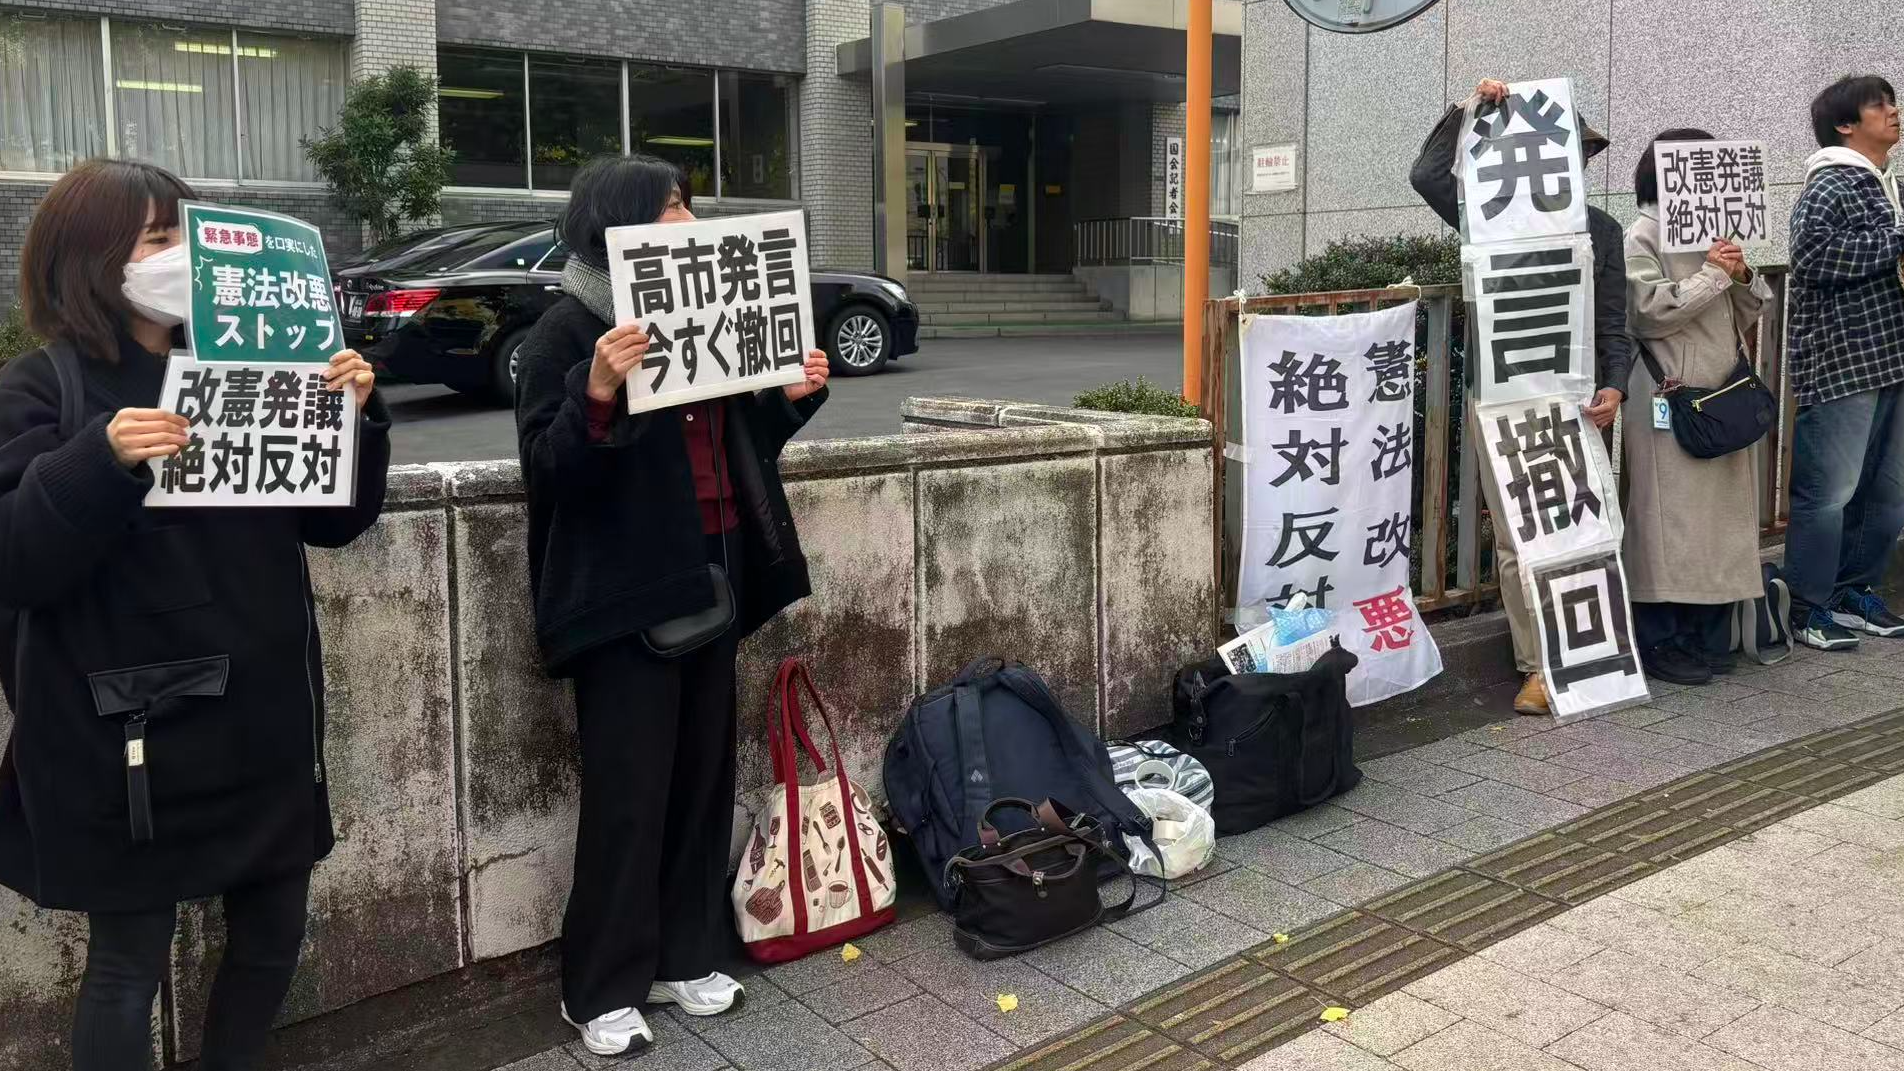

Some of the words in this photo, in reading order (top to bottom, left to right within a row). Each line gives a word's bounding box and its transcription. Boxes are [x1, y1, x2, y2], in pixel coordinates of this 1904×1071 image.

[1661, 145, 1766, 197] 改憲発議
[204, 226, 259, 248] 緊急事態
[265, 235, 318, 260] を口実にした
[1666, 193, 1767, 247] 絶対反対
[211, 263, 332, 312] 憲法改悪
[622, 228, 797, 319] 高市発言
[214, 313, 336, 351] ストップ
[641, 302, 805, 394] 今すぐ撤回
[175, 367, 345, 432] 改憲発議
[160, 432, 342, 495] 絶対反対
[1353, 339, 1414, 653] 憲法改悪
